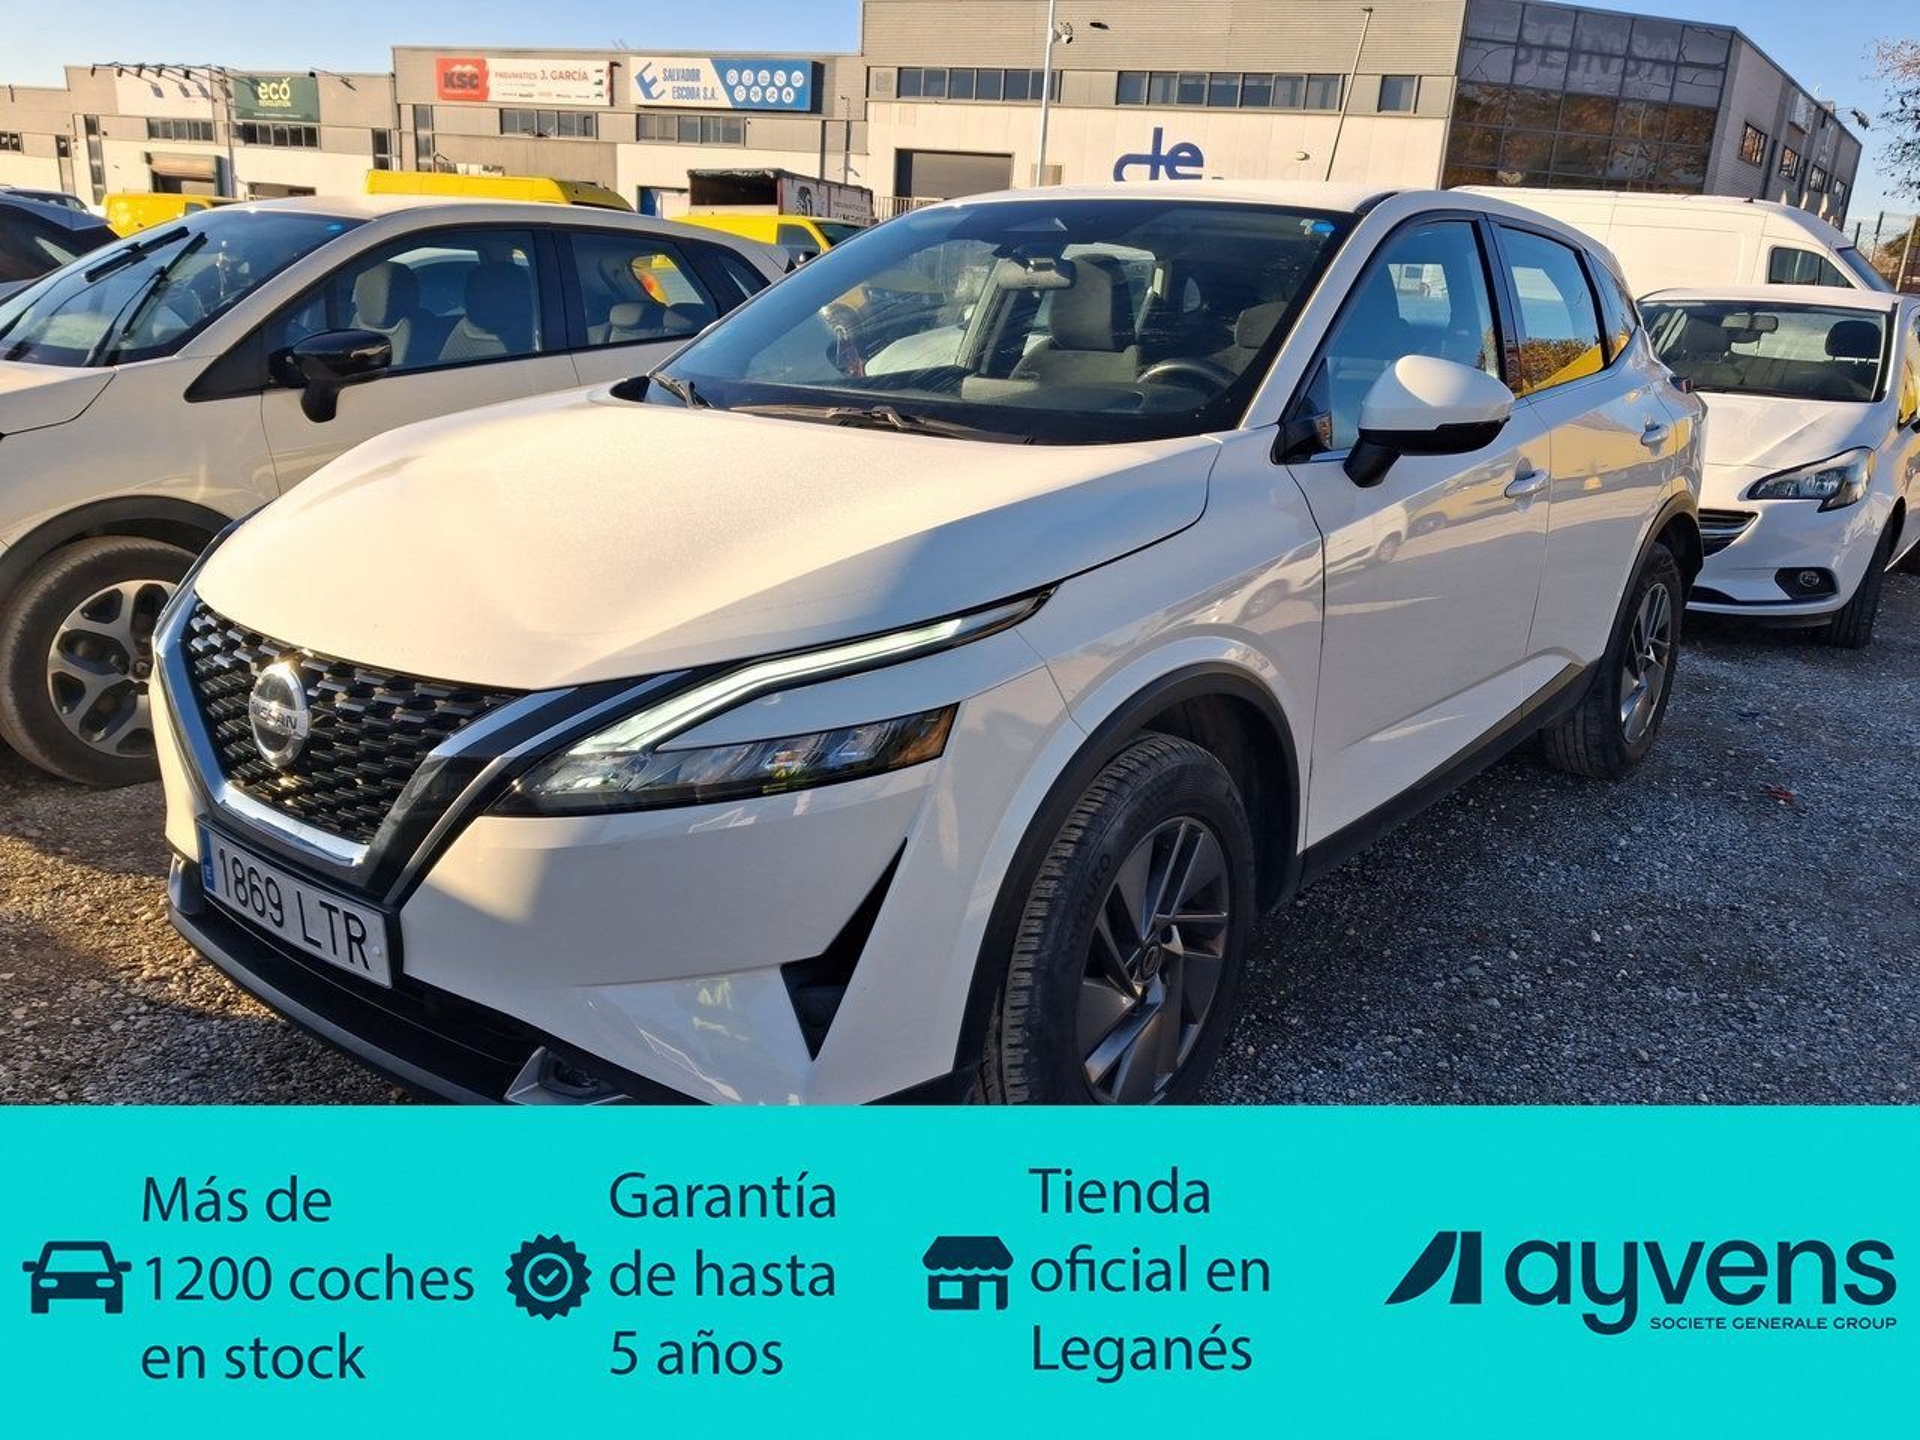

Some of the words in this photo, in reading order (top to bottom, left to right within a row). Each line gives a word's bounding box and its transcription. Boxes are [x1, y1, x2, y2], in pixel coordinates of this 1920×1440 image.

[443, 72, 479, 89] KSC
[541, 70, 548, 80] J.
[662, 68, 701, 82] SALVADOR
[219, 848, 284, 928] 1869
[296, 890, 370, 970] LTR
